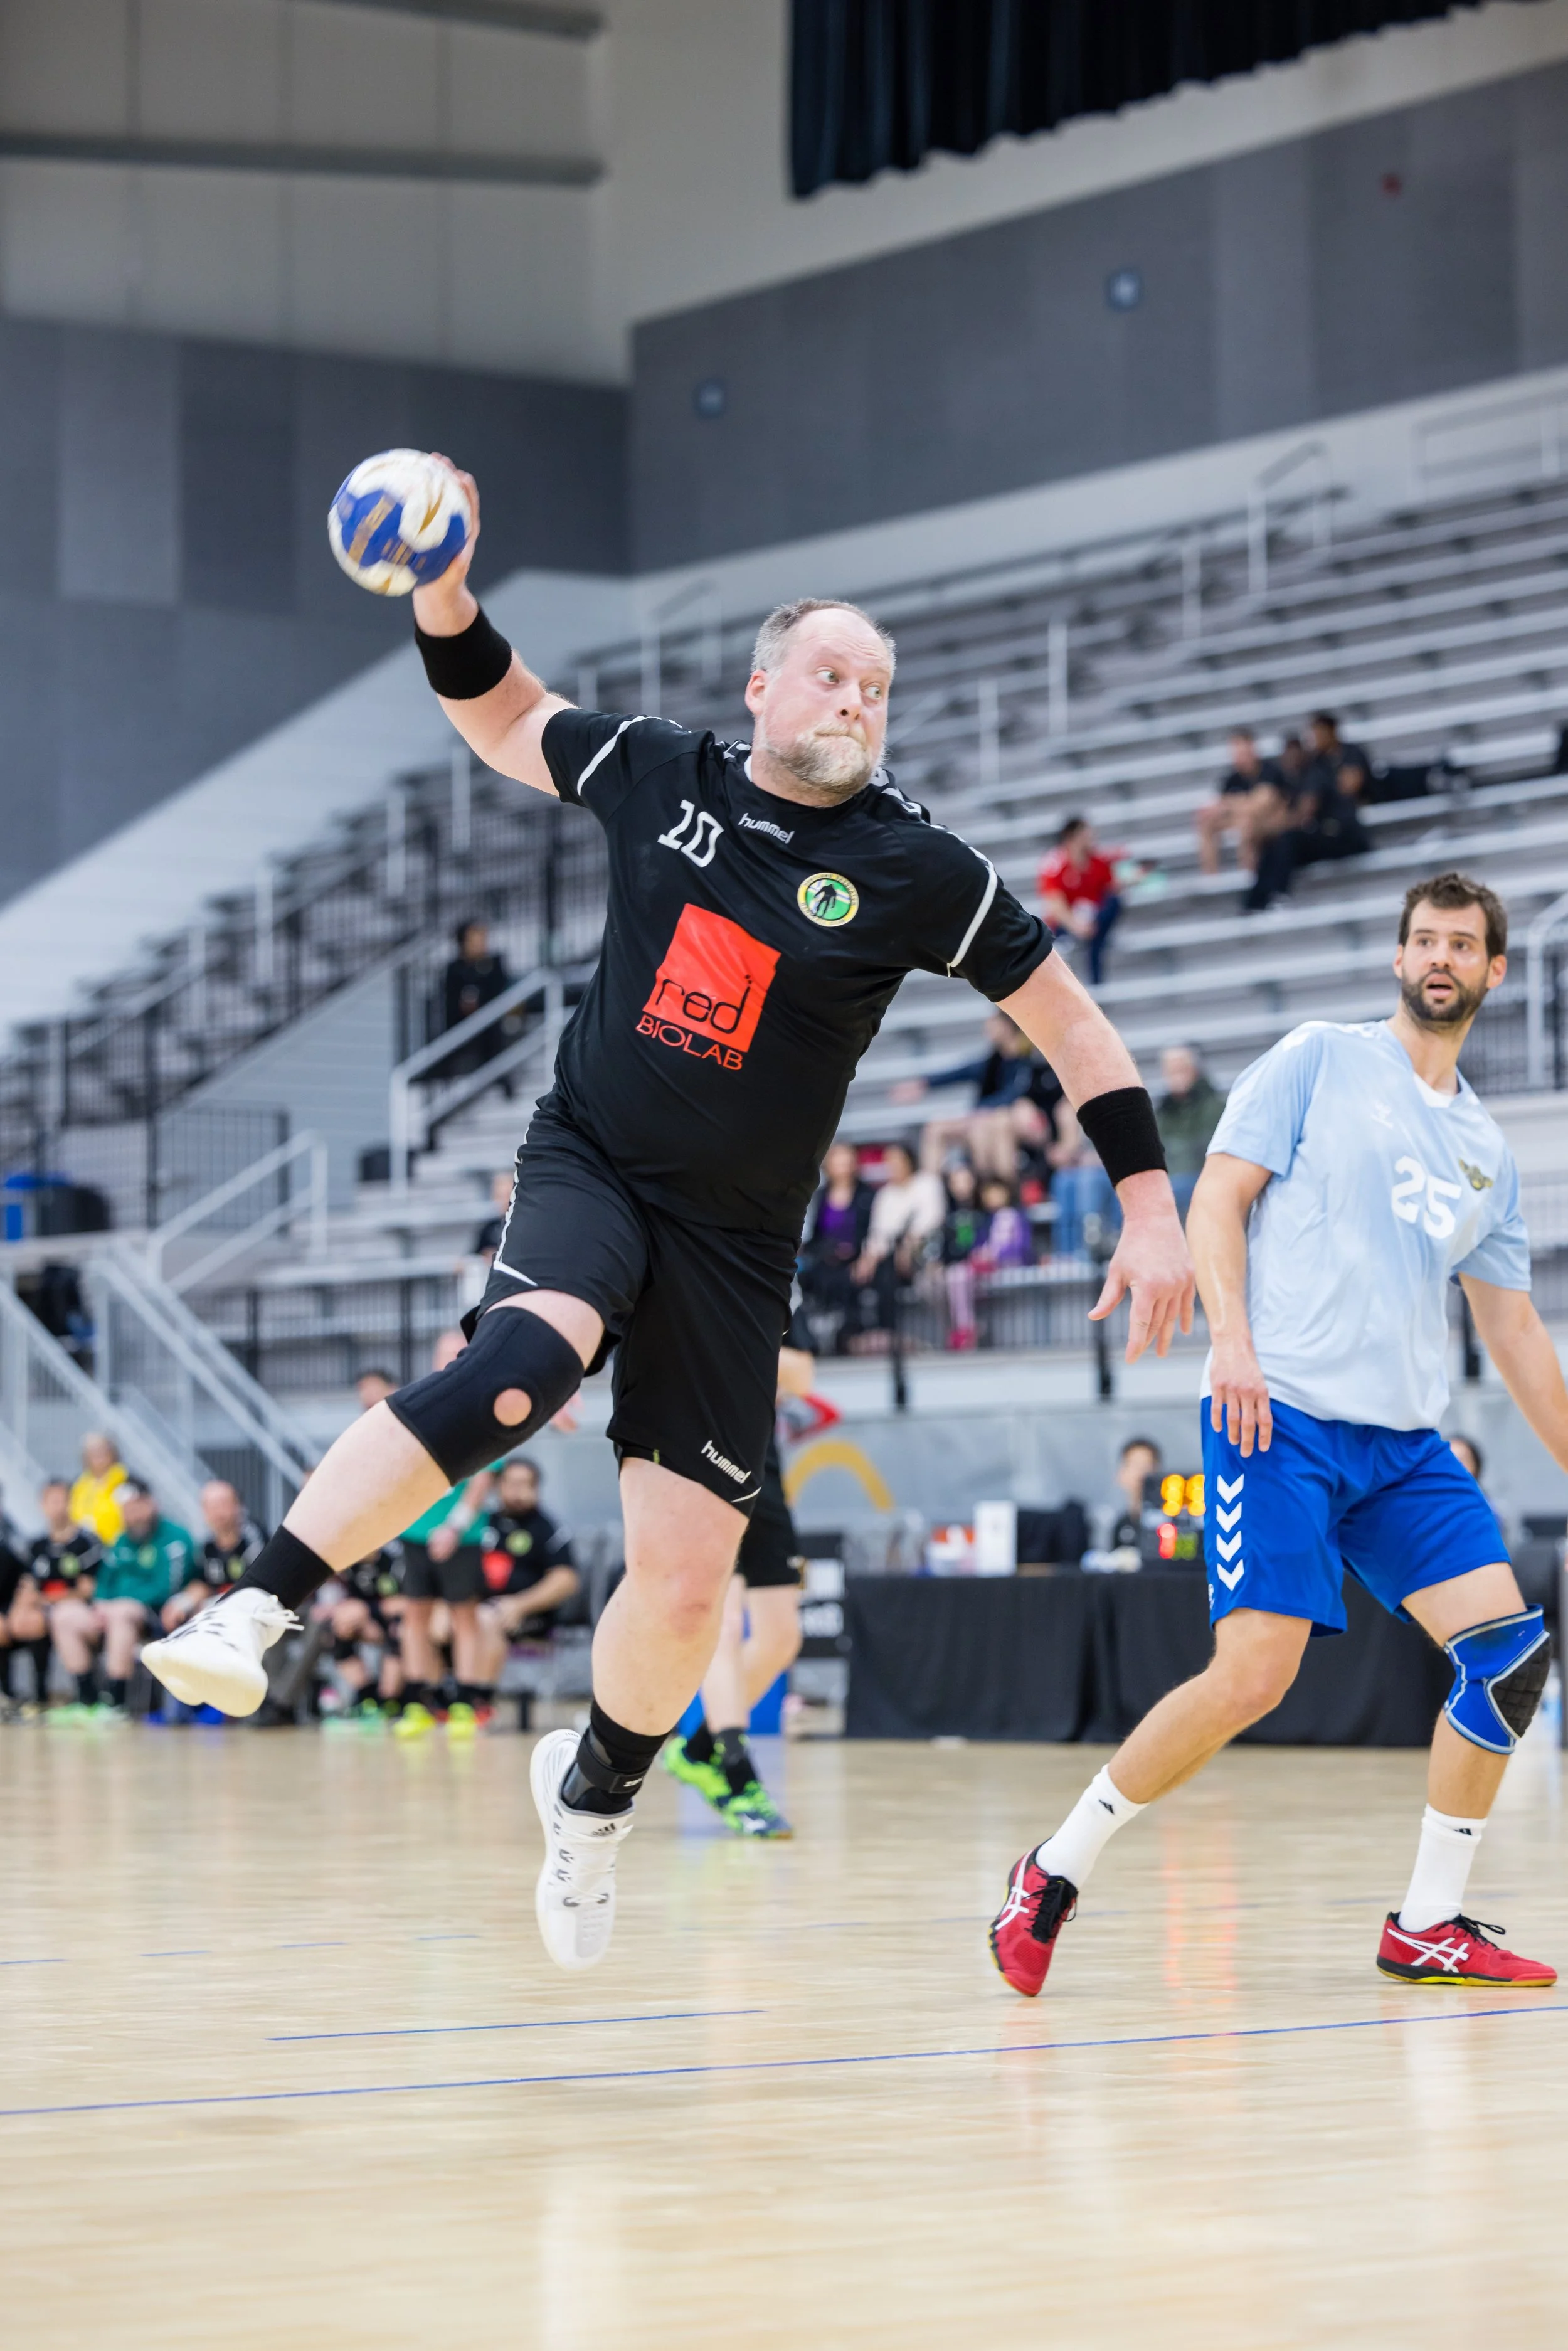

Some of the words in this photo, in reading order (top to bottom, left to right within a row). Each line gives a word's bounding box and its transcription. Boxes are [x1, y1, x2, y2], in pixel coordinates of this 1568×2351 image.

[657, 799, 724, 868] 10
[738, 812, 795, 844] hummel
[655, 975, 751, 1034] red
[635, 1014, 743, 1071] BIOLAB
[1391, 1155, 1463, 1239] 25
[701, 1440, 752, 1484] hummel
